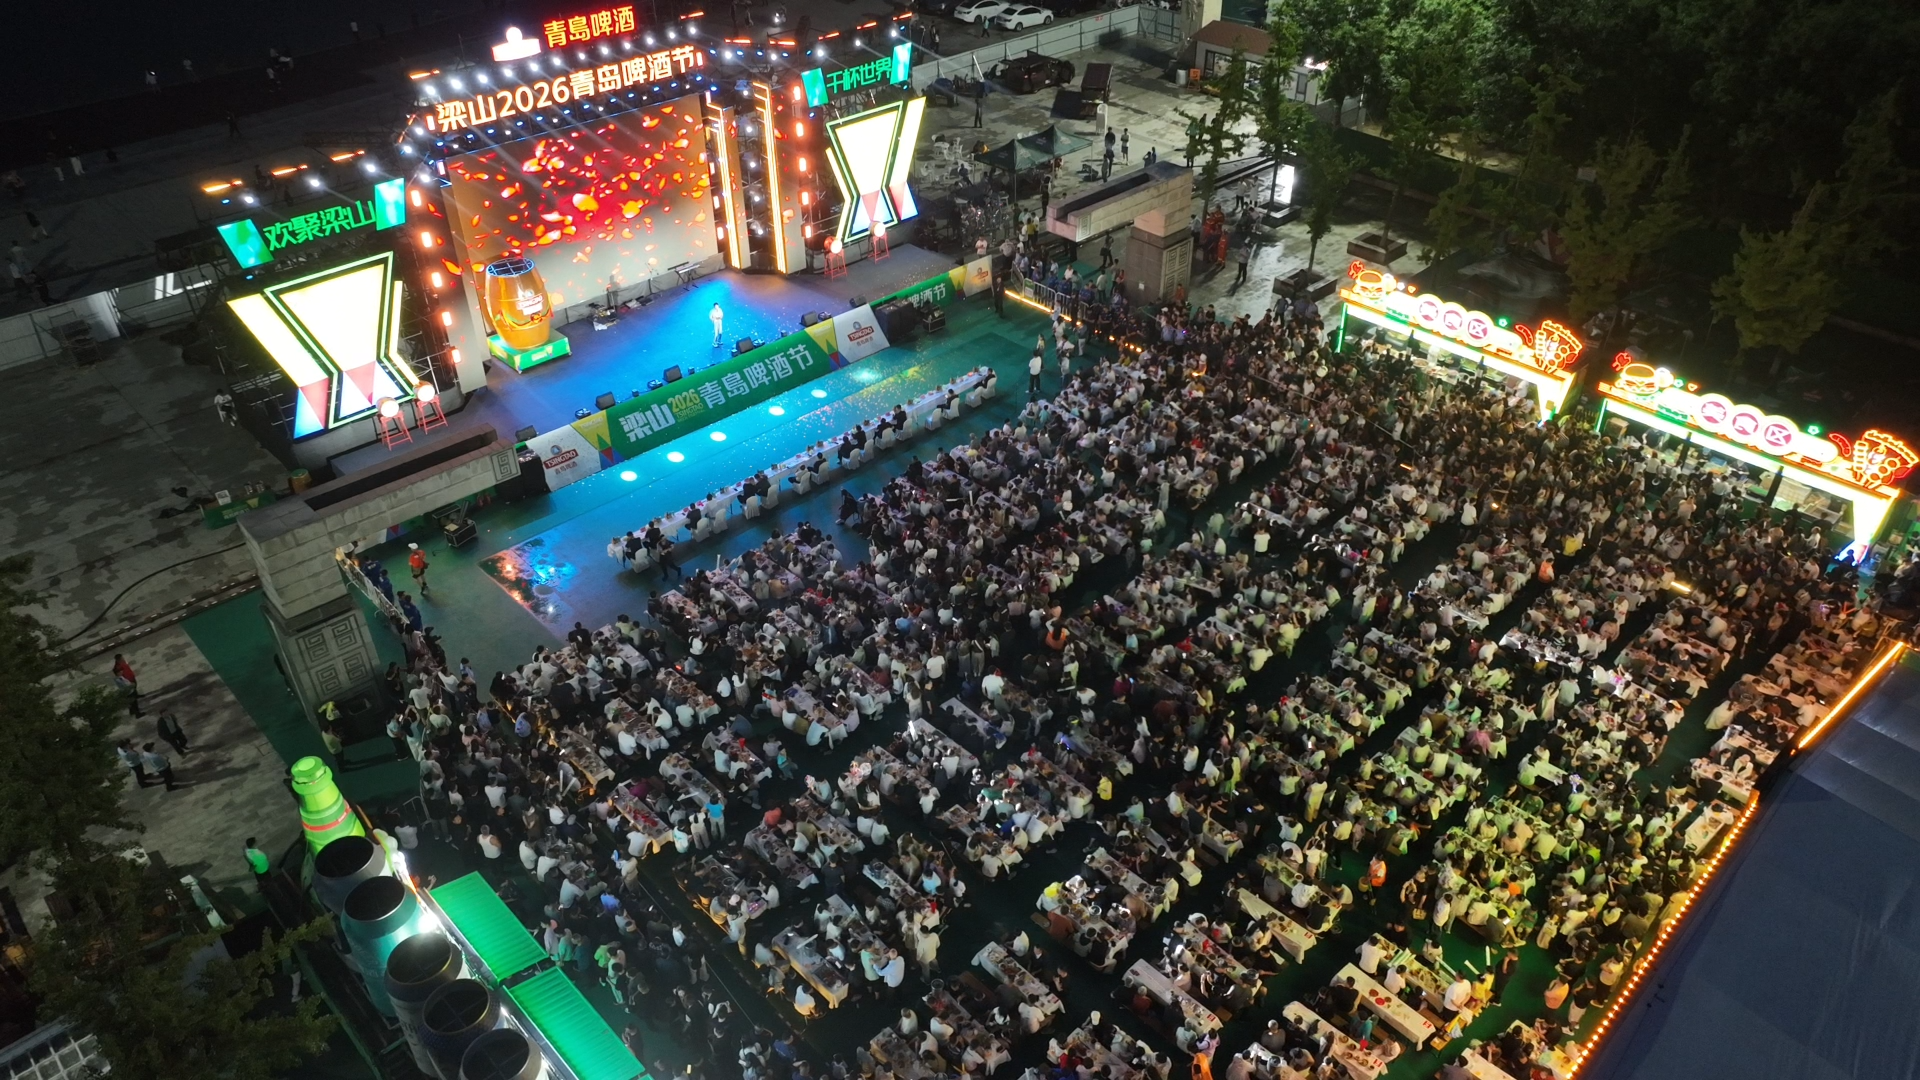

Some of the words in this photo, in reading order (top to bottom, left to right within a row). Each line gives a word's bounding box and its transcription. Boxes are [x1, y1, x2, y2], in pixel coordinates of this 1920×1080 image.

[544, 6, 634, 48] 青島啤酒
[436, 46, 695, 132] 梁山2026青岛啤酒节
[826, 56, 892, 94] 干杯世界
[263, 200, 375, 251] 欢聚梁山
[618, 403, 676, 442] 梁山
[667, 389, 700, 413] 2026
[697, 344, 814, 409] 青島啤酒节
[546, 449, 577, 467] TSINGTAO
